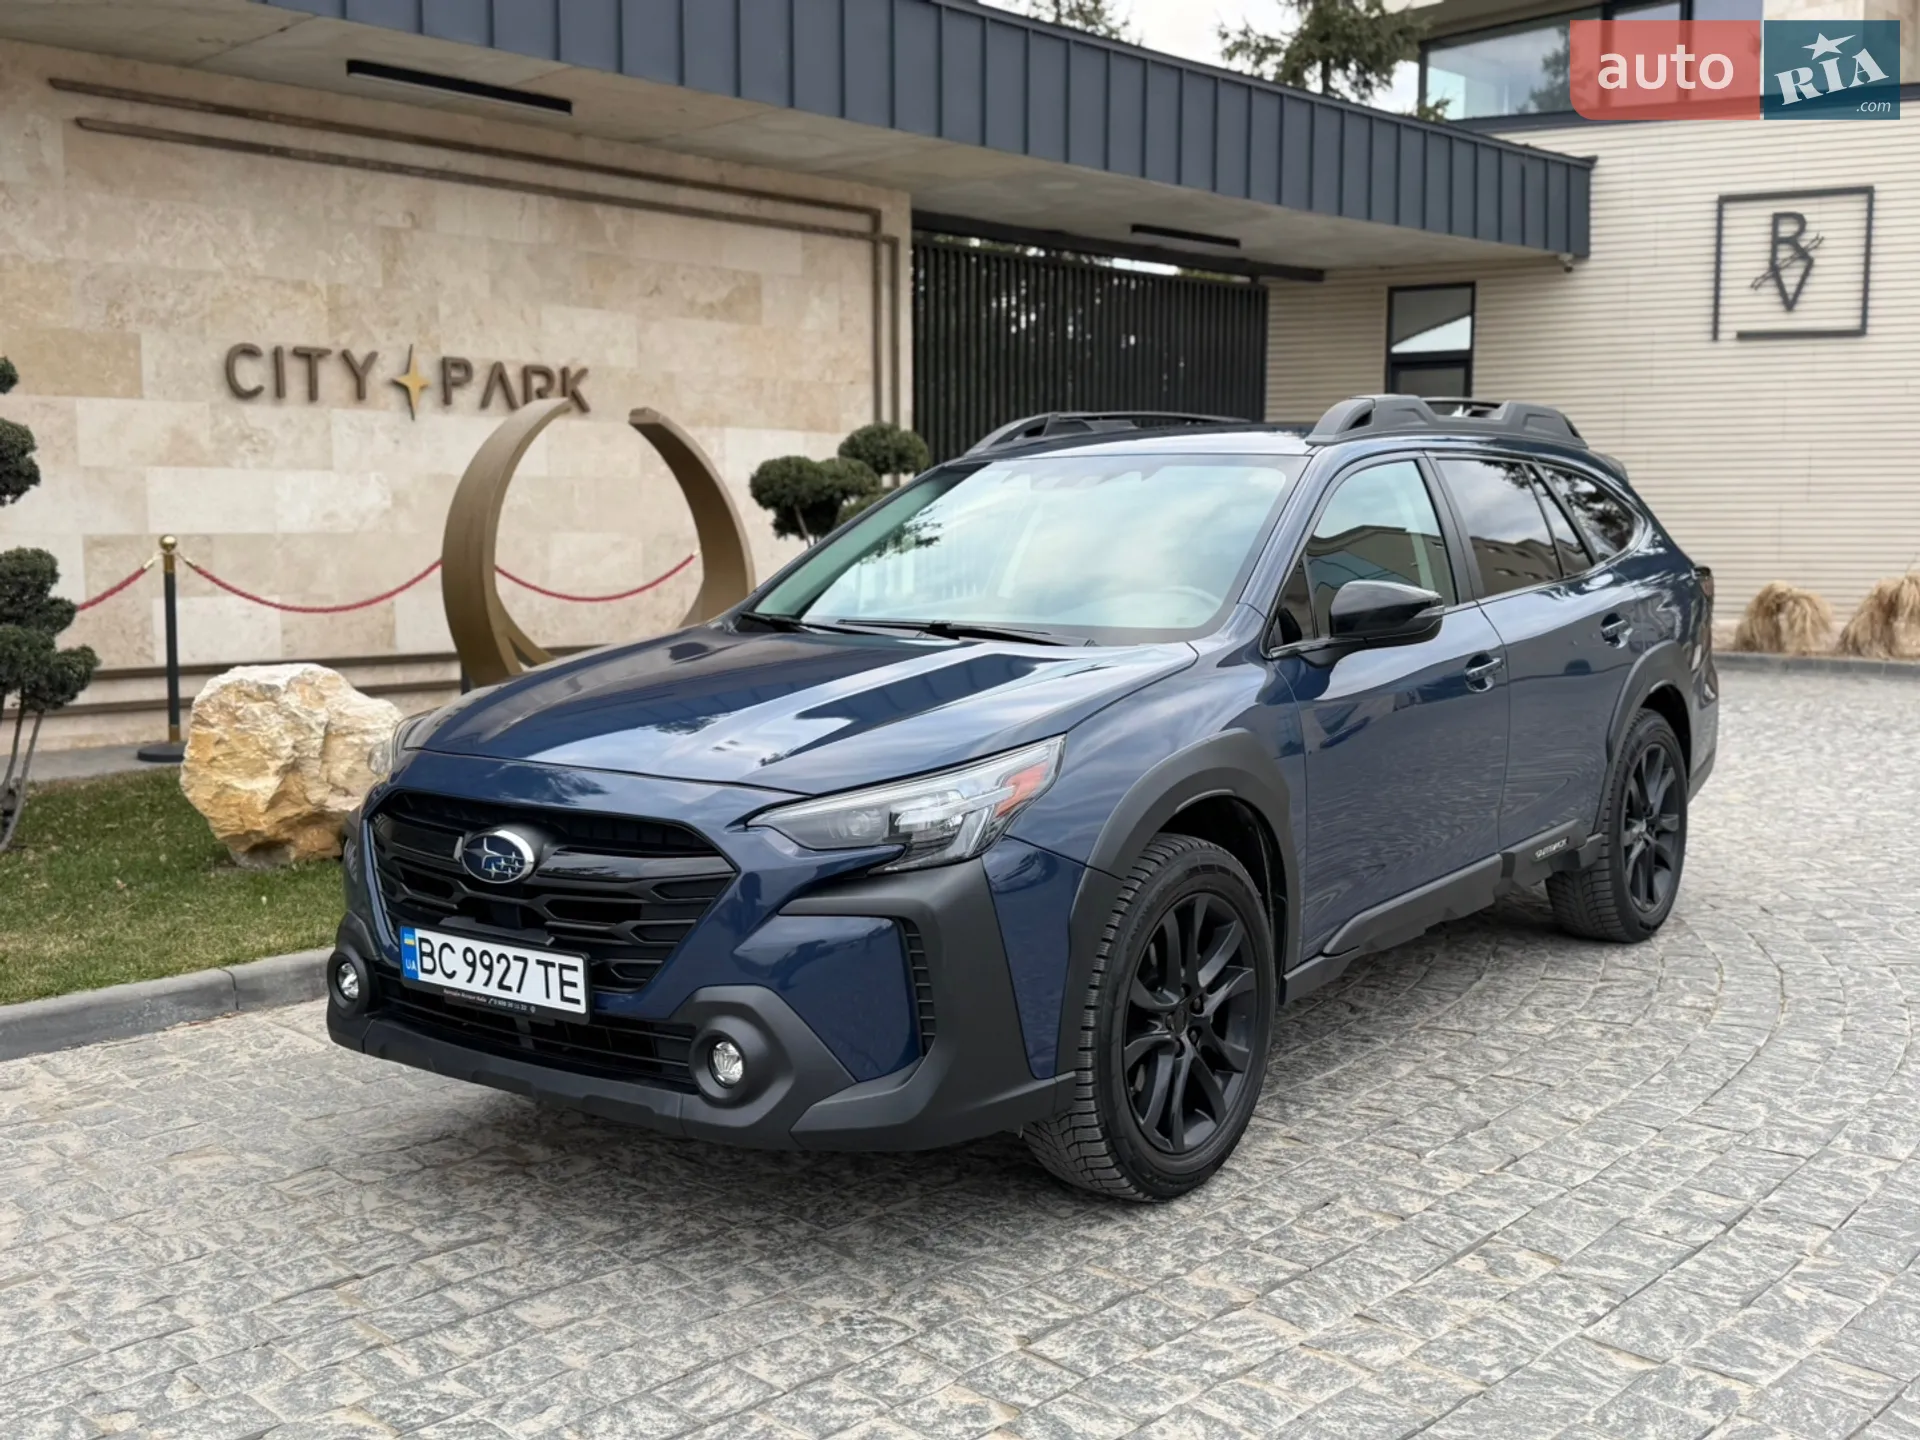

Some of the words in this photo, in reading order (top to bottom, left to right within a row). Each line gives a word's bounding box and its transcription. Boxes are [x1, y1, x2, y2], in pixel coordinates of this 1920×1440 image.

[225, 342, 379, 401] CITY
[441, 356, 591, 414] PARK
[405, 957, 417, 971] UA
[417, 936, 457, 980] BC
[462, 946, 529, 994] 9927
[535, 958, 581, 1006] TE
